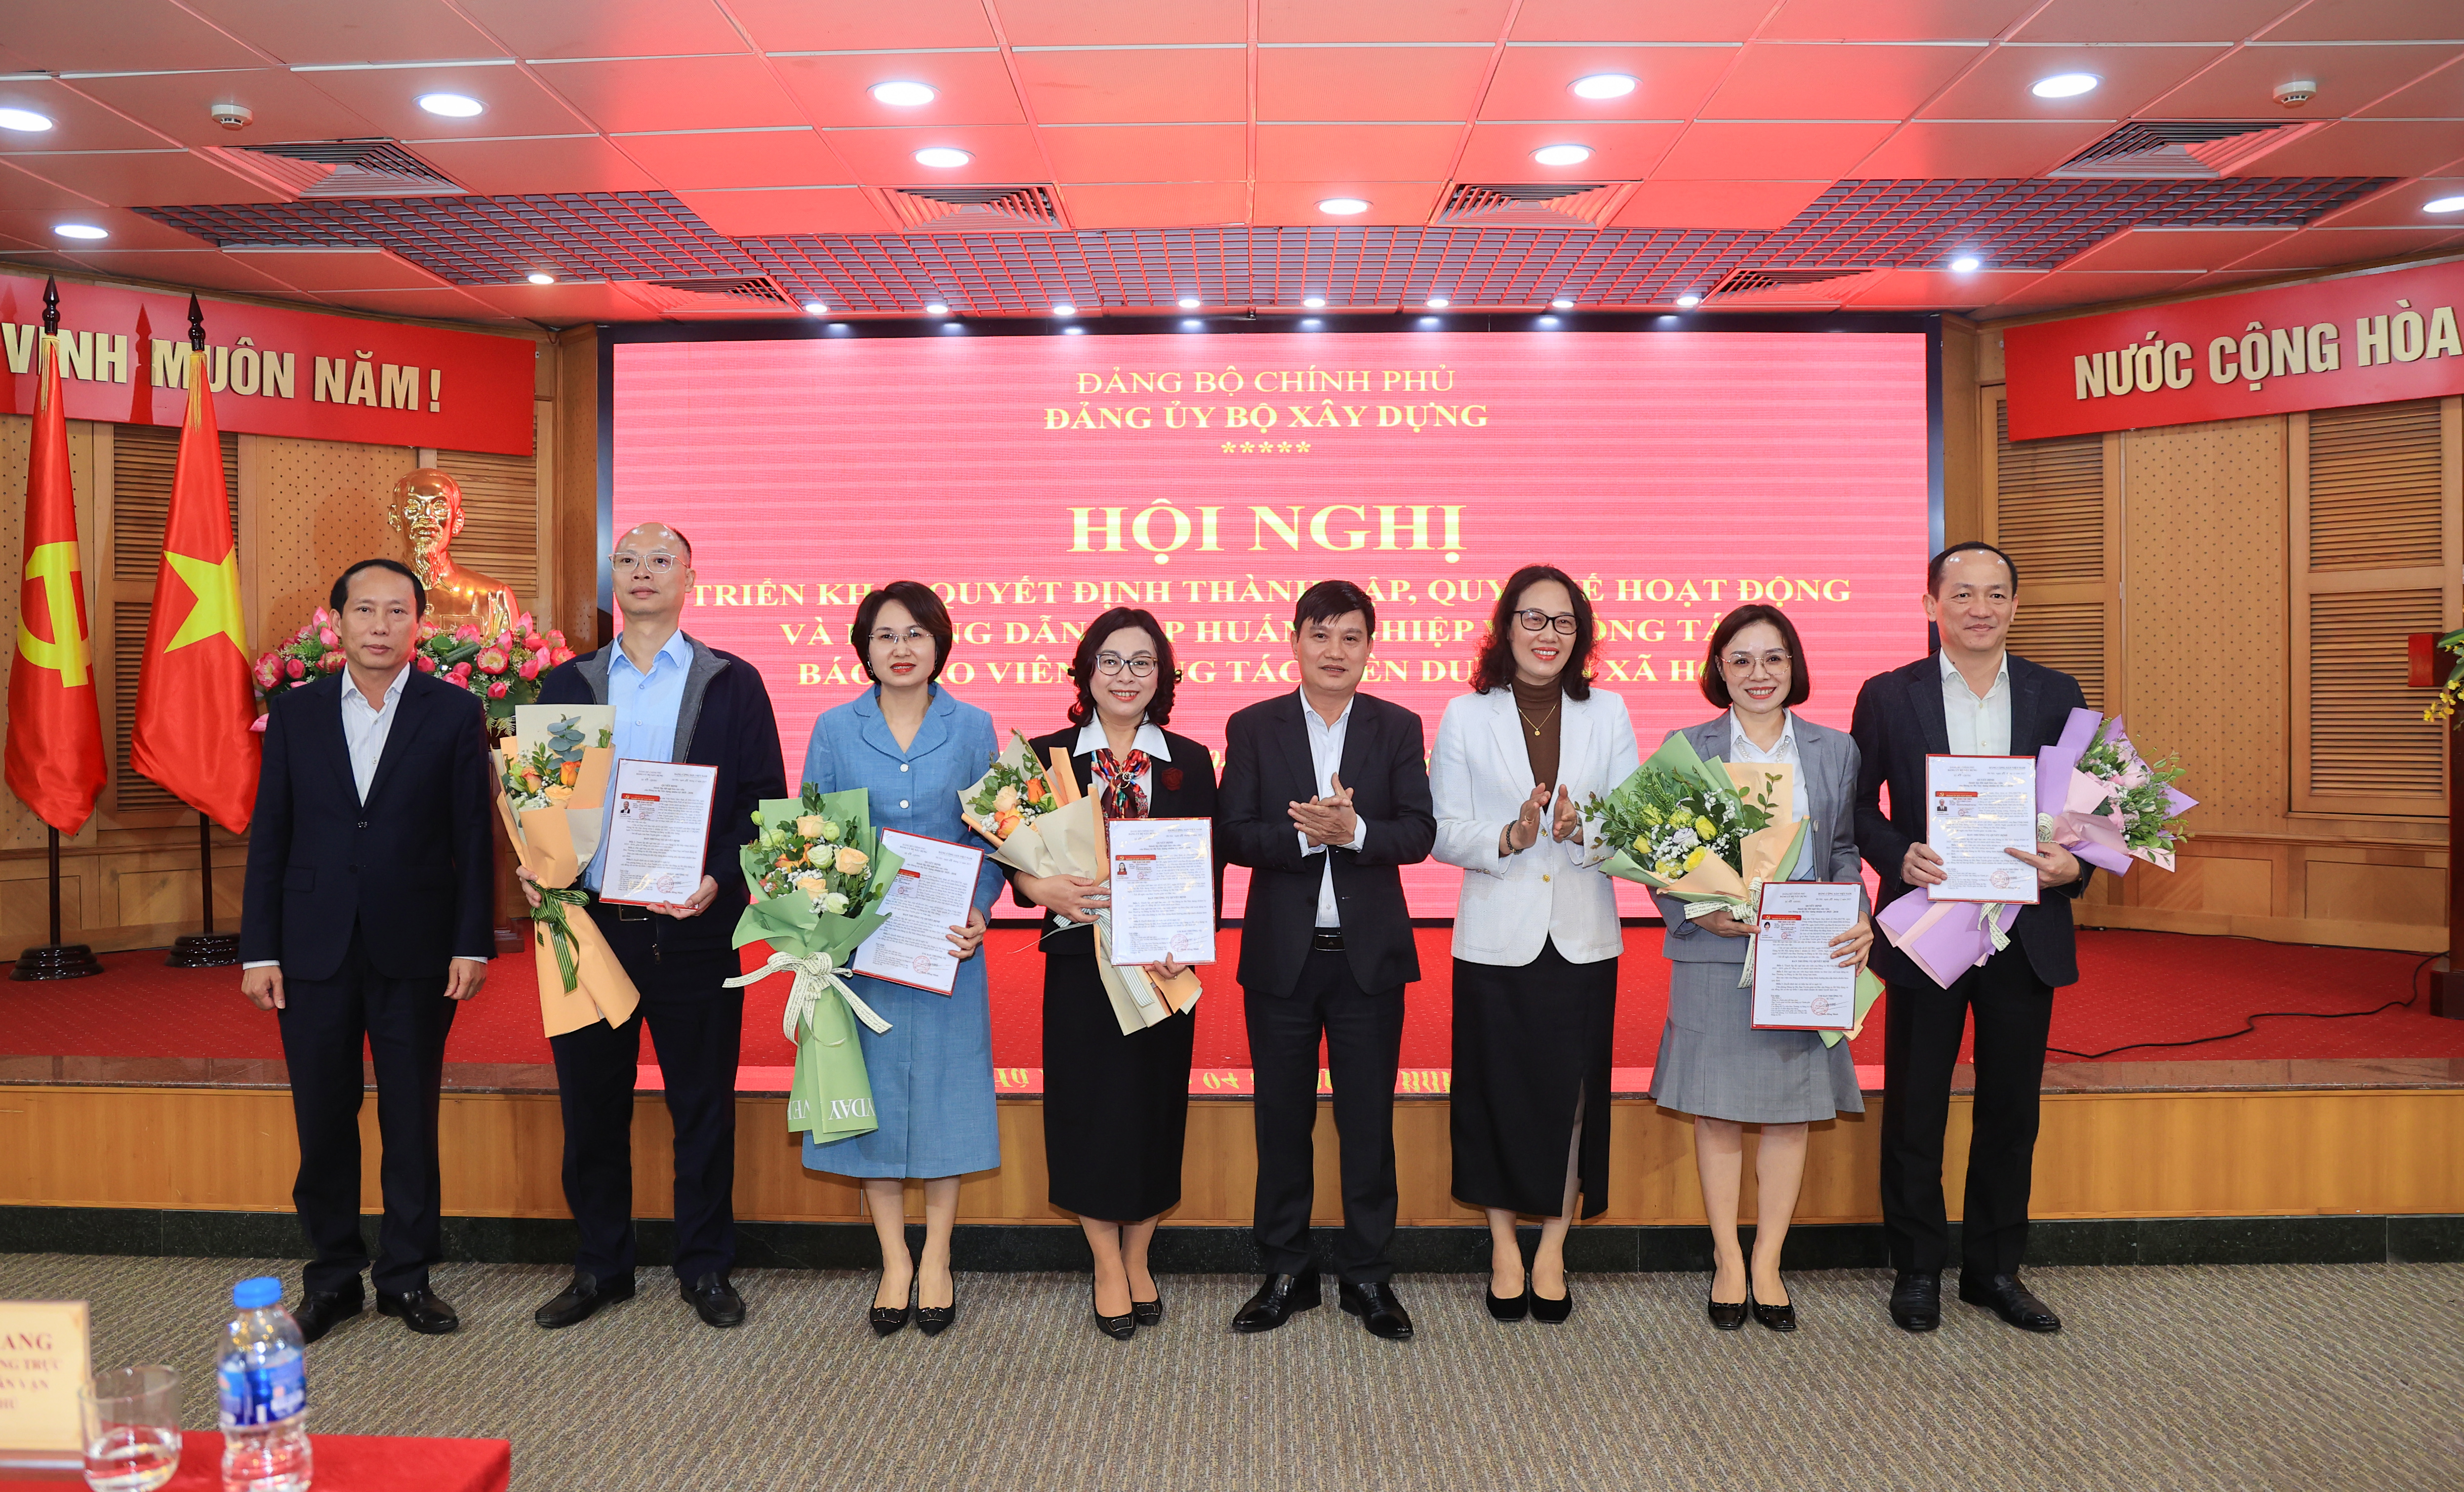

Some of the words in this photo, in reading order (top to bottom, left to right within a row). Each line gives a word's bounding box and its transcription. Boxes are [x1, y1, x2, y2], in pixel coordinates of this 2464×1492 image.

[2074, 330, 2194, 401] NƯỚC
[2208, 320, 2341, 392] CỘNG
[2356, 298, 2464, 367] HÒA
[151, 336, 295, 399] MUÔN
[1077, 367, 1181, 393] ĐẢNG
[1193, 365, 1244, 396] BỘ
[1254, 364, 1371, 392] CHÍNH
[1382, 364, 1455, 391] PHỦ
[1044, 401, 1152, 429] ĐẢNG
[1163, 400, 1215, 428] ỦY
[1224, 403, 1277, 433] BỘ
[1287, 399, 1368, 427] XÂY
[1376, 402, 1488, 433] DỰNG
[1066, 498, 1224, 565] HỘI
[1247, 504, 1467, 563] NGHỊ
[692, 578, 805, 605] TRIỂN
[816, 583, 875, 605] KH
[929, 575, 1062, 609] QUYẾT
[1072, 581, 1172, 609] ĐỊNH
[1365, 576, 1416, 606] ẬP,
[1616, 579, 1727, 607] HOẠT
[1737, 576, 1851, 607] ĐỘNG
[779, 617, 834, 645] VÀ
[1003, 615, 1087, 643] DẪN
[1372, 616, 1474, 647] HIỆP
[1677, 612, 1722, 641] TÁ
[1604, 654, 1658, 681] XÃ
